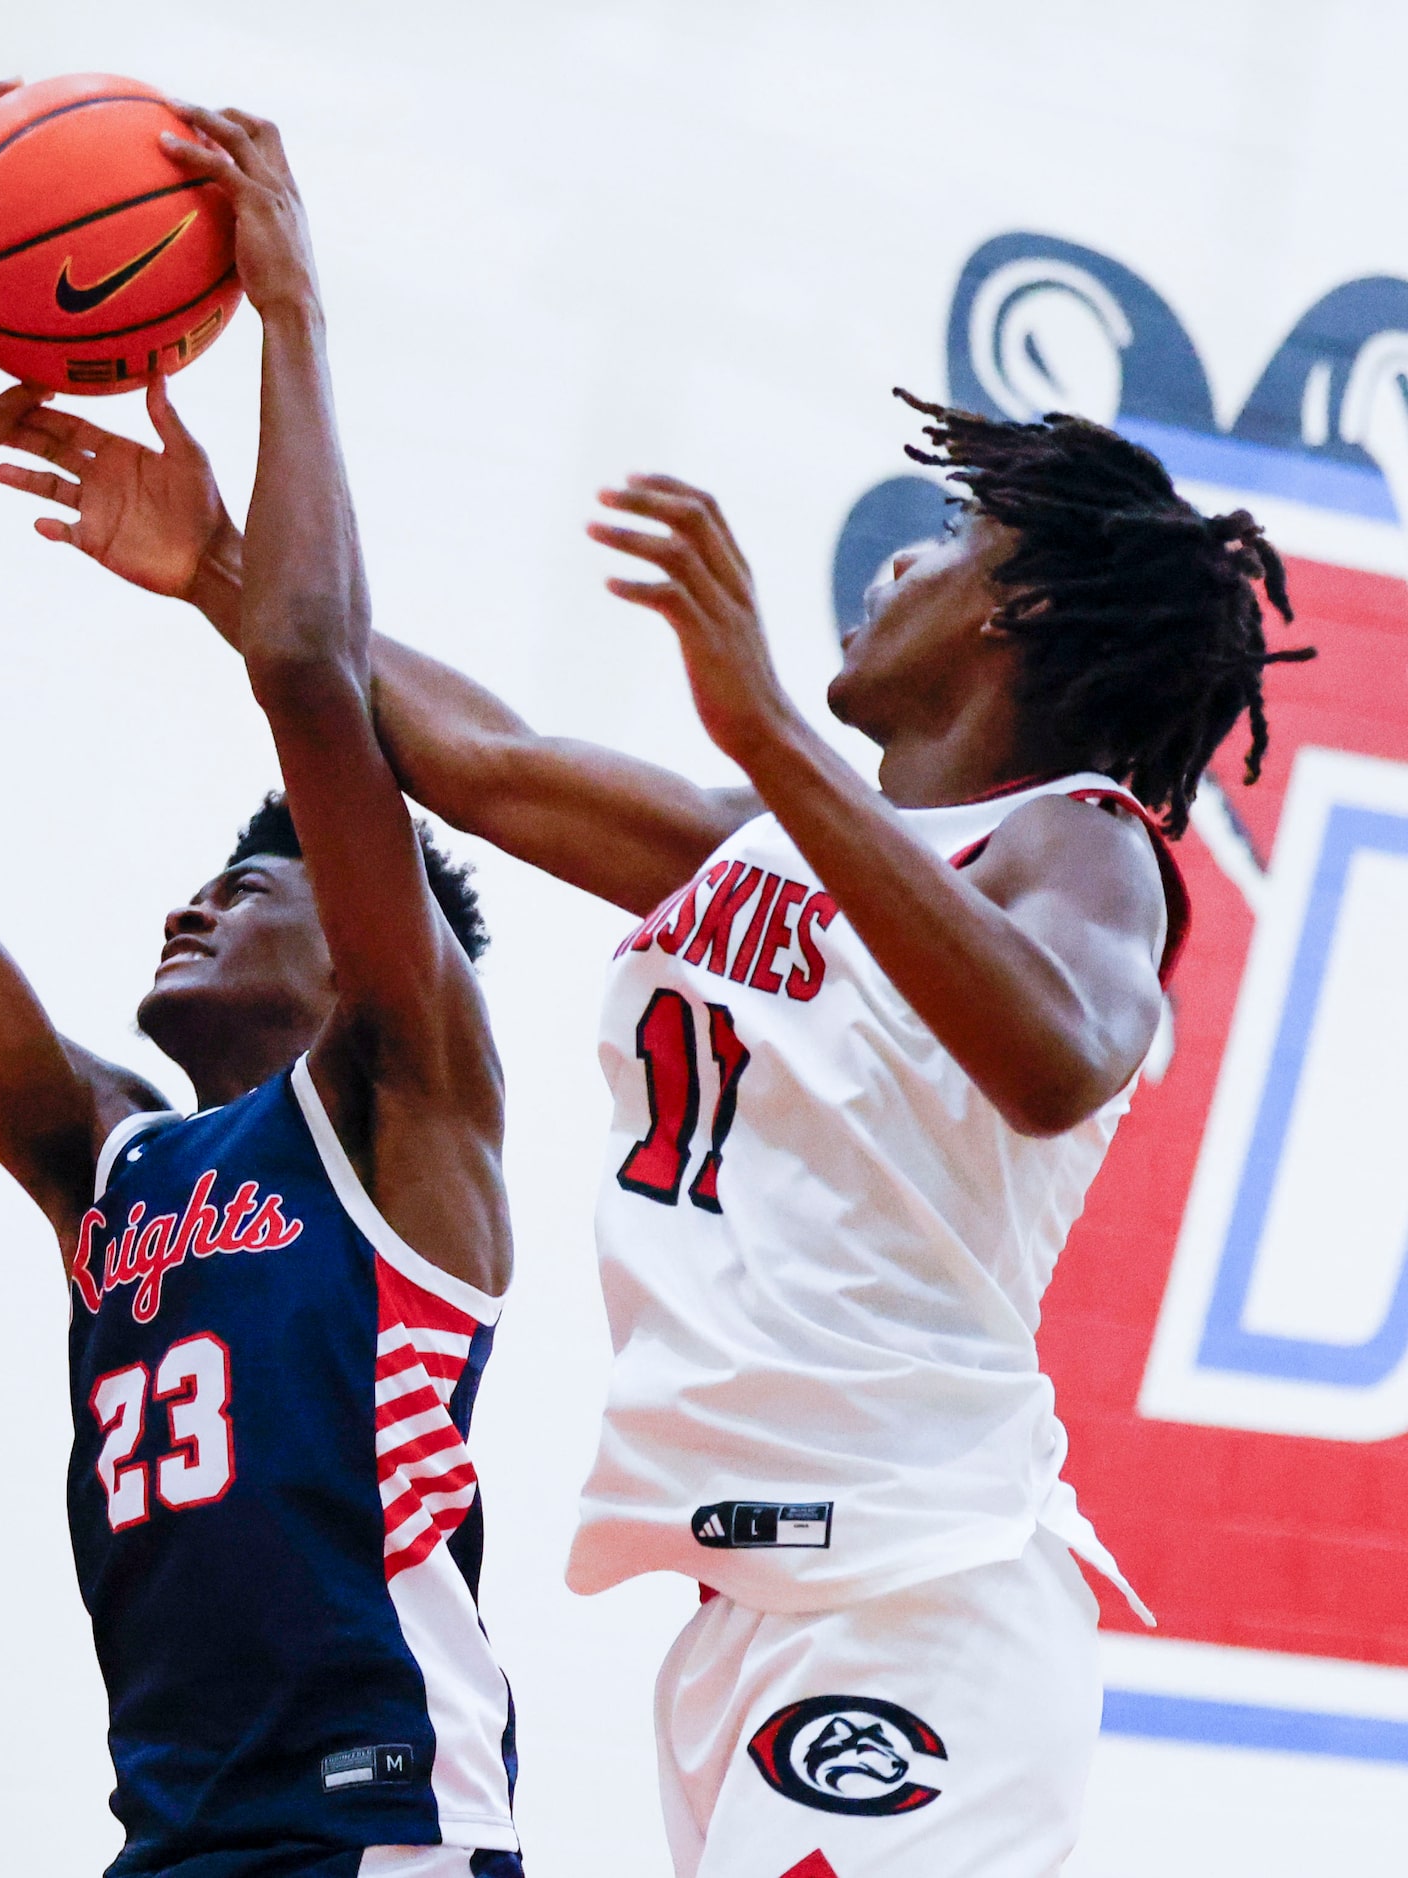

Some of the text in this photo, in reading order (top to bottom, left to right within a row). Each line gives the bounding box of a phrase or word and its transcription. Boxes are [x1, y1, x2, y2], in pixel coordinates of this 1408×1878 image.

[616, 987, 751, 1215] 11
[89, 1330, 237, 1534] 23
[751, 1519, 759, 1537] L
[385, 1754, 404, 1773] M
